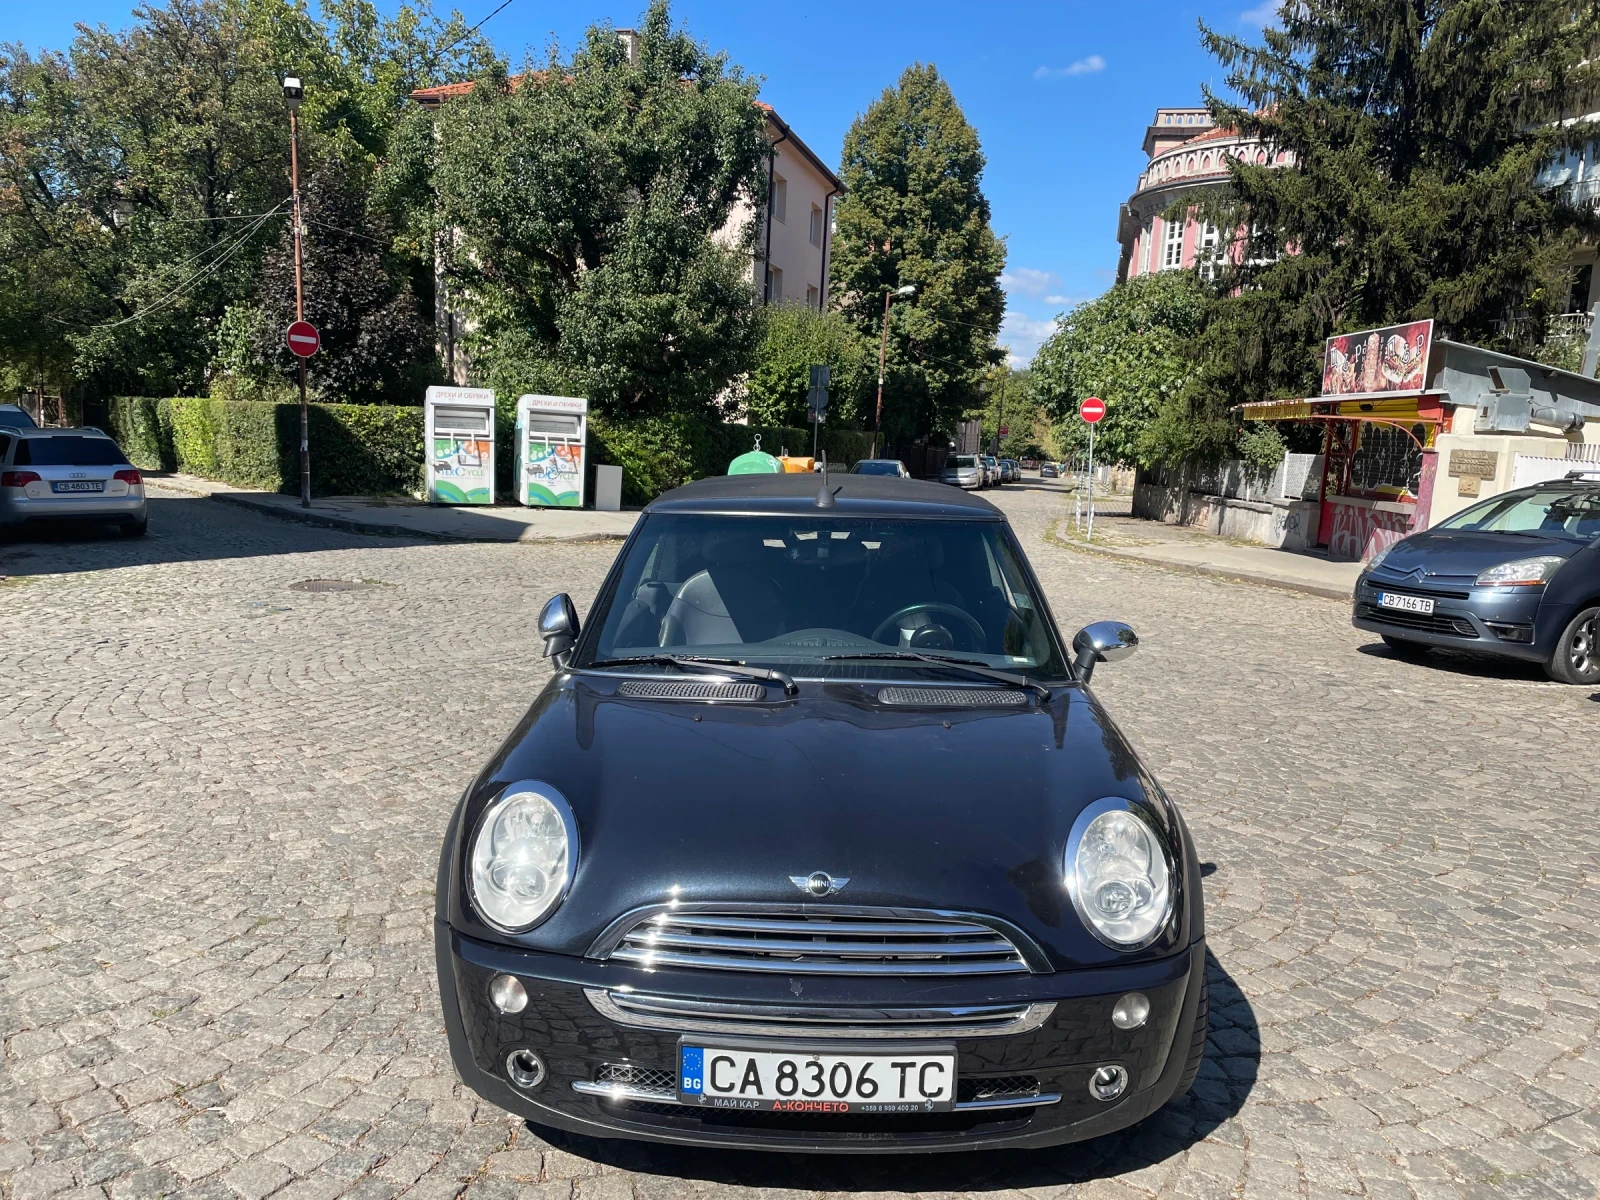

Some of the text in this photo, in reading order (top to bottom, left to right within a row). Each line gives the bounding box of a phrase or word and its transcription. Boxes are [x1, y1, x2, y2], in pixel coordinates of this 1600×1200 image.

[532, 399, 552, 407] ДРЕХИ
[71, 482, 90, 490] 4803
[1383, 594, 1431, 611] CB 7166 TB
[809, 879, 830, 888] MINI
[683, 1077, 702, 1090] BG
[709, 1055, 945, 1099] CA 8306 TC
[714, 1098, 737, 1108] МАЙ
[740, 1100, 760, 1109] КАР
[773, 1100, 849, 1113] А-КОНЧЕТО
